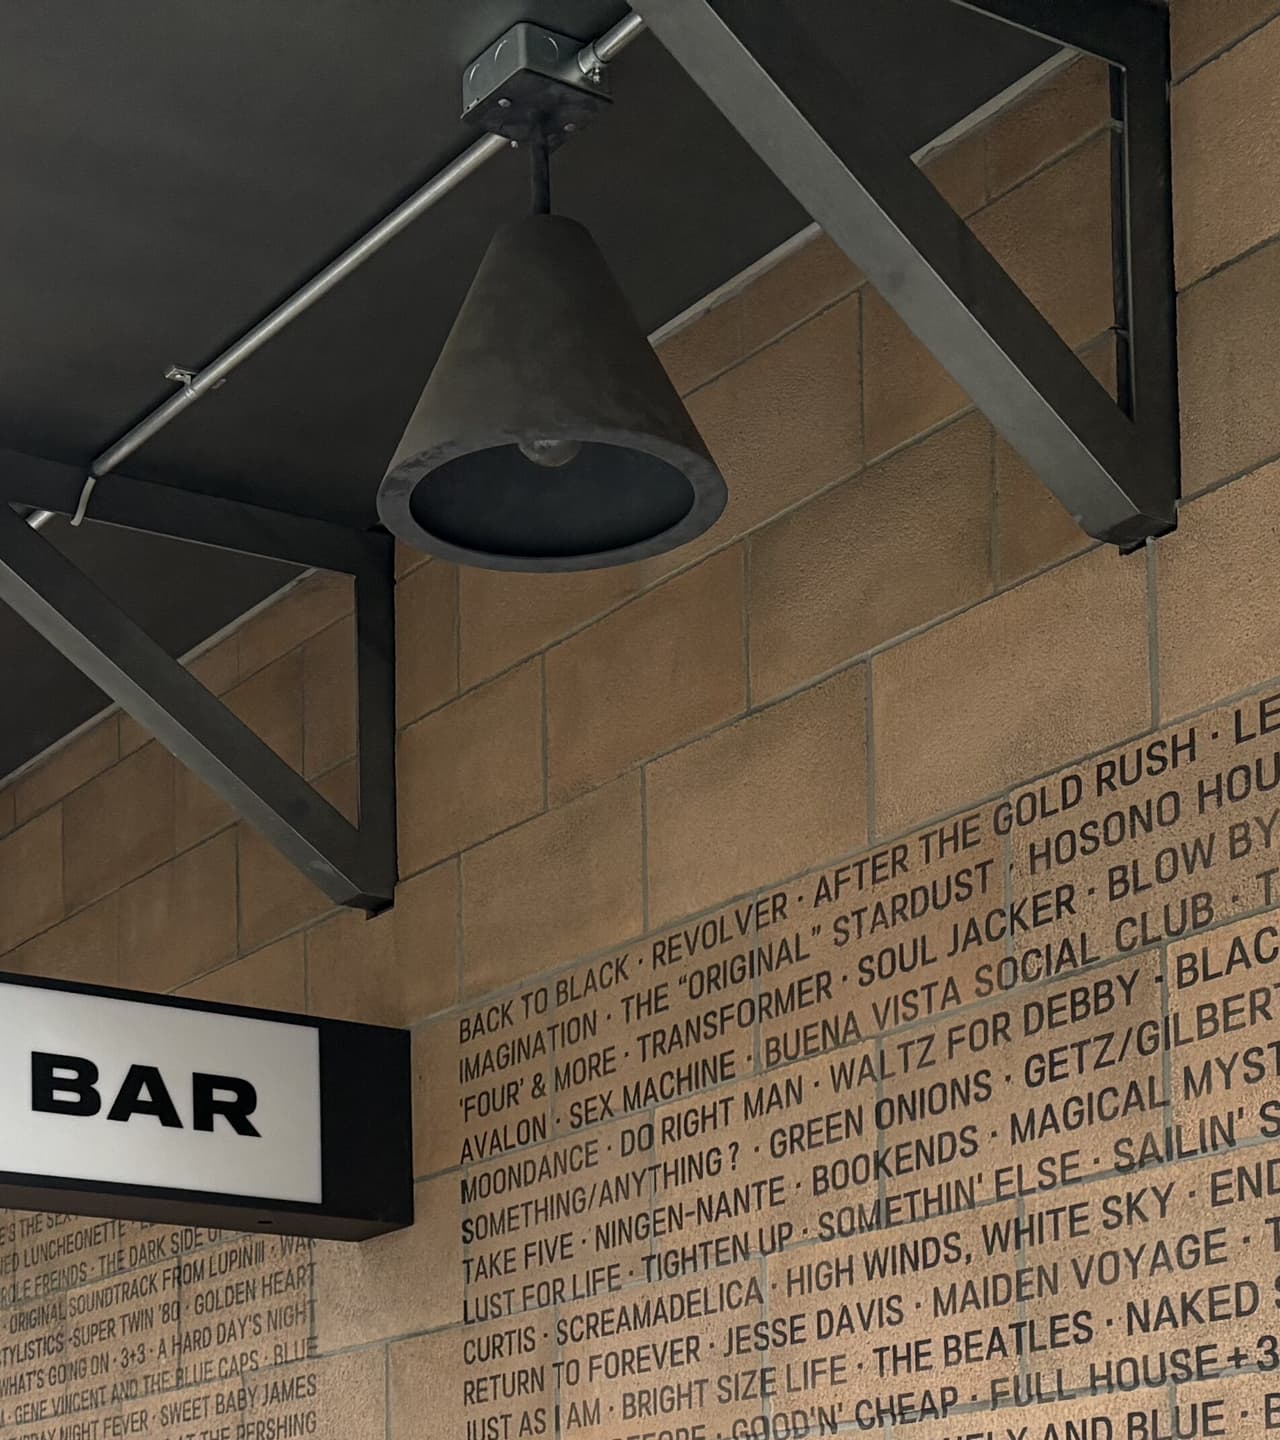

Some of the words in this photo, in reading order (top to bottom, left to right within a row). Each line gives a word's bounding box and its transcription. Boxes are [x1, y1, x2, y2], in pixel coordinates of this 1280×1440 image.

[459, 999, 513, 1045] BACK
[520, 985, 547, 1021] TO
[555, 953, 628, 1007] BLACK
[652, 890, 787, 970] REVOLVER
[812, 842, 908, 908] AFTER
[918, 812, 981, 867] THE
[992, 771, 1082, 838] GOLD
[1095, 726, 1196, 798] RUSH
[31, 1051, 261, 1138] BAR
[459, 1111, 546, 1165] AVALON
[569, 1089, 613, 1131] SEX
[622, 1048, 735, 1113] MACHINE
[765, 1007, 861, 1069] BUENA
[871, 973, 960, 1032] VISTA
[974, 926, 1100, 999] SOCIAL
[1114, 888, 1214, 955] CLUB
[461, 1246, 516, 1285] TAKE
[524, 1231, 573, 1270] FIVE
[595, 1174, 785, 1251] NINGEN-NANTE
[812, 1123, 978, 1196] BOOKENDS
[1010, 1071, 1170, 1145] MAGICAL
[193, 1277, 255, 1317] GOLDEN
[261, 1261, 316, 1298] HEART
[463, 1364, 544, 1406] RETURN
[551, 1357, 579, 1389] TO
[588, 1333, 700, 1382] FOREVER
[722, 1313, 806, 1358] JESSE
[816, 1293, 904, 1340] DAVIS
[932, 1262, 1058, 1318] MAIDEN
[1070, 1227, 1227, 1291] VOYAGE
[160, 1394, 210, 1427] SWEET
[215, 1385, 257, 1416] BABY
[261, 1372, 316, 1406] JAMES
